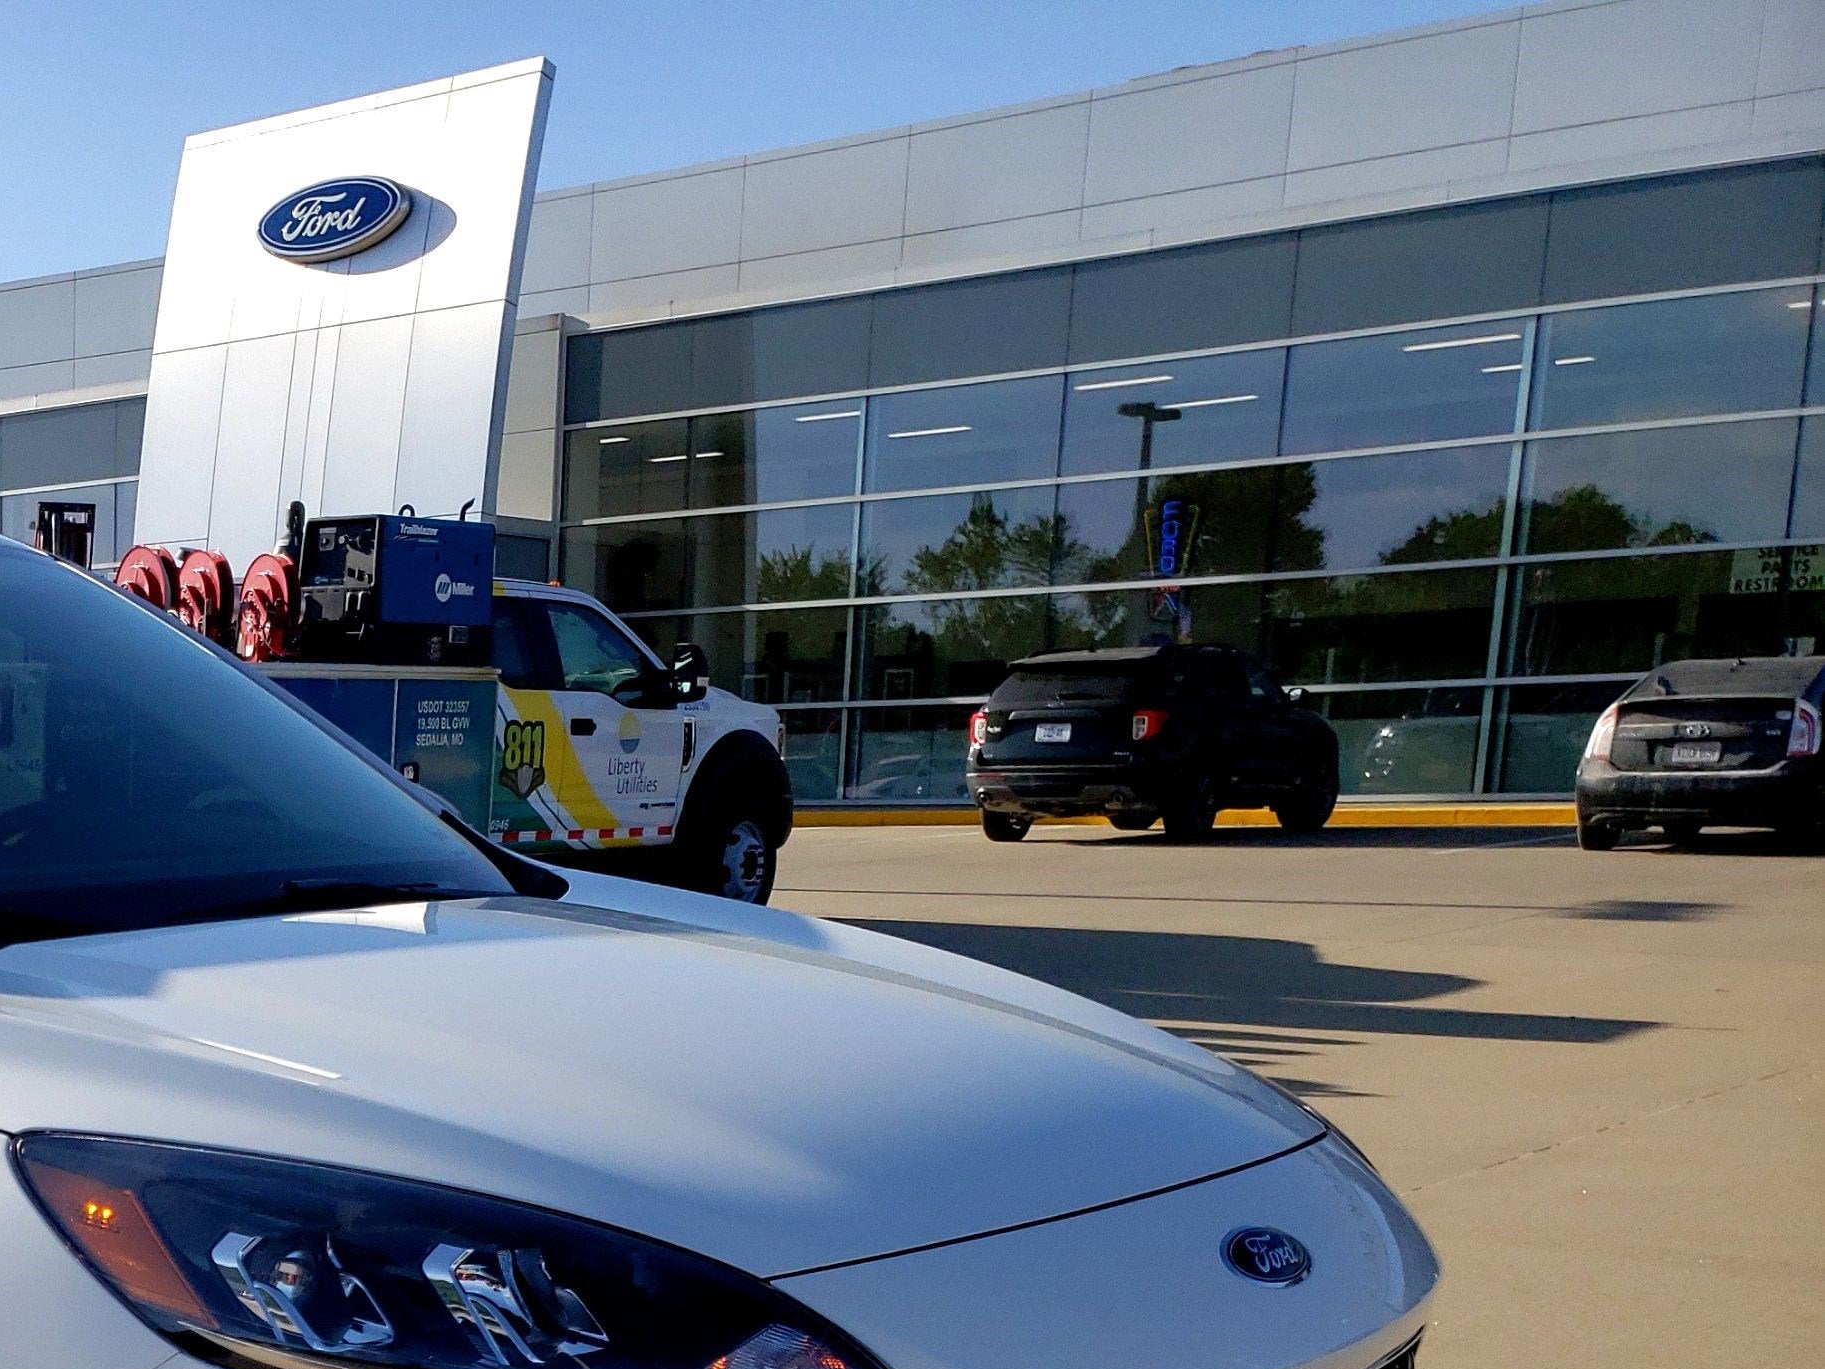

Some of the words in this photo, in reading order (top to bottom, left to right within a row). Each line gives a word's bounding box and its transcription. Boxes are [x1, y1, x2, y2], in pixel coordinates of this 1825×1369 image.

[281, 192, 367, 242] Ford
[1160, 501, 1182, 577] FORD
[1761, 558, 1811, 574] PATS
[451, 581, 474, 597] Miller
[417, 700, 444, 714] USDOT
[452, 717, 470, 730] GVW
[451, 732, 464, 746] MO
[505, 724, 544, 770] 811
[607, 757, 646, 776] Liberty
[616, 777, 658, 795] Utilities
[1245, 1234, 1299, 1273] Ford
